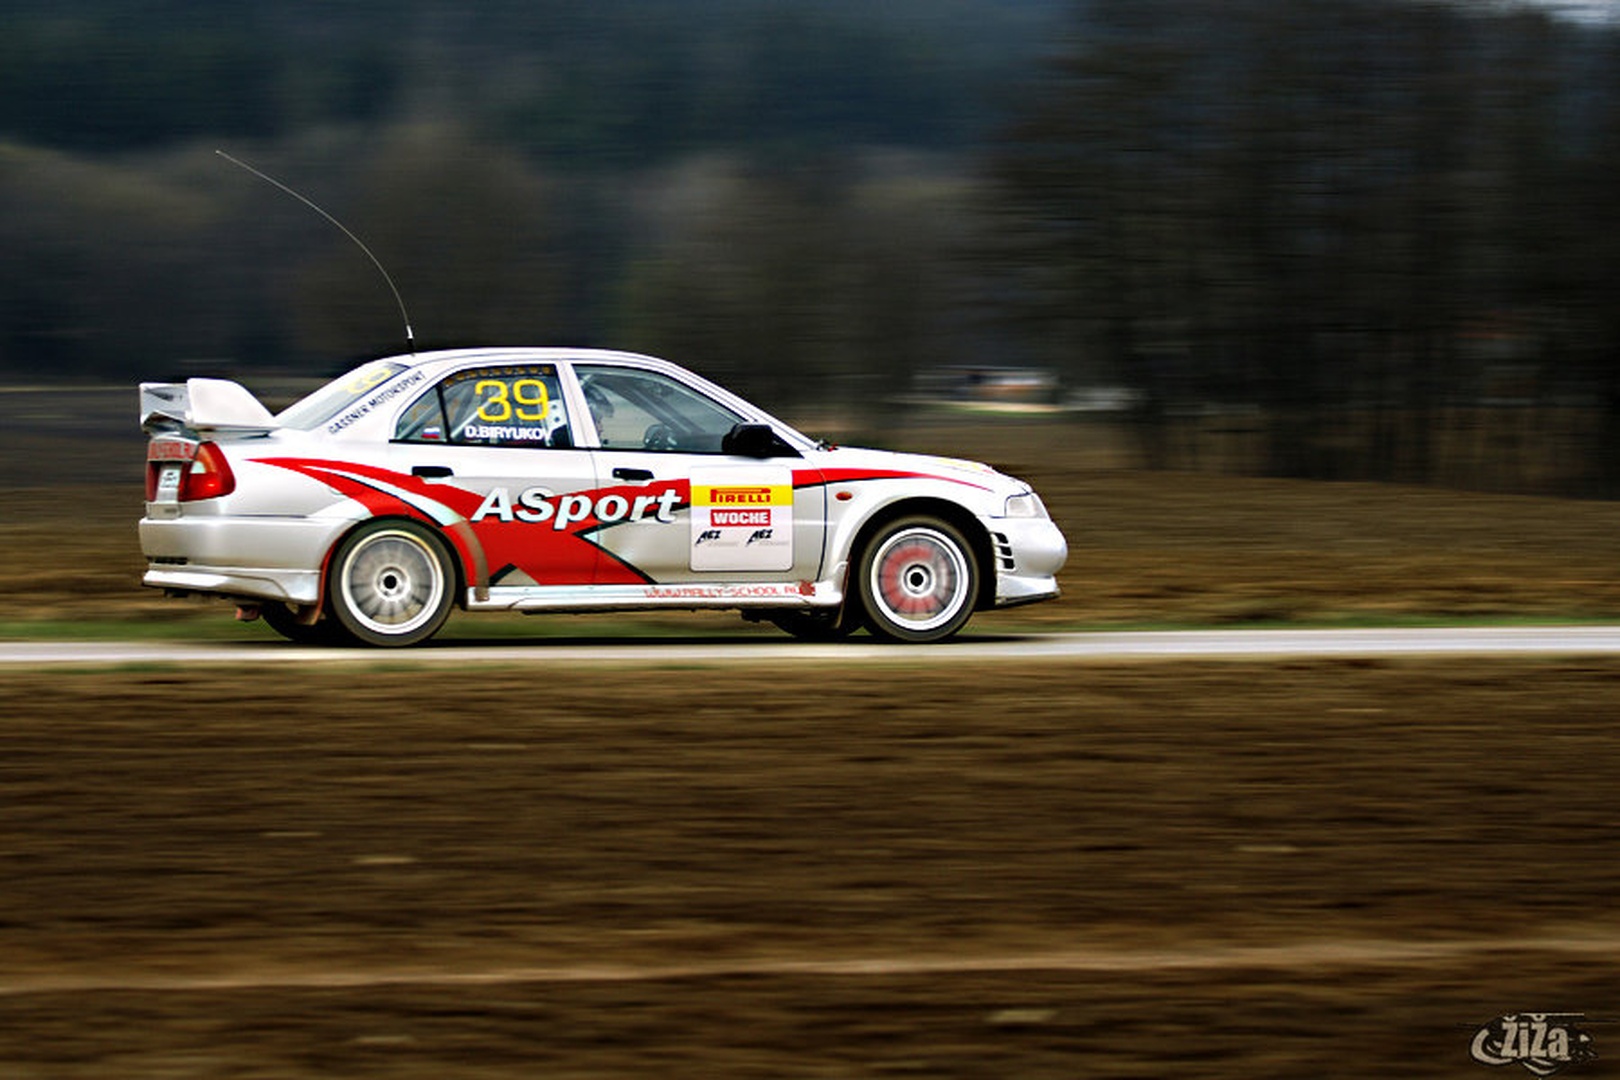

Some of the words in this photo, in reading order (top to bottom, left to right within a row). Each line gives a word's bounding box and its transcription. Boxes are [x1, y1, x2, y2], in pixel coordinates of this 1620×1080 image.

[328, 404, 370, 434] GASSNER
[368, 370, 426, 408] MOTORSPORT
[474, 378, 549, 421] 39
[464, 425, 552, 441] D.BIRYUKOV
[470, 487, 682, 530] ASport
[710, 487, 771, 503] PIRELLI
[712, 511, 769, 525] WOCHE
